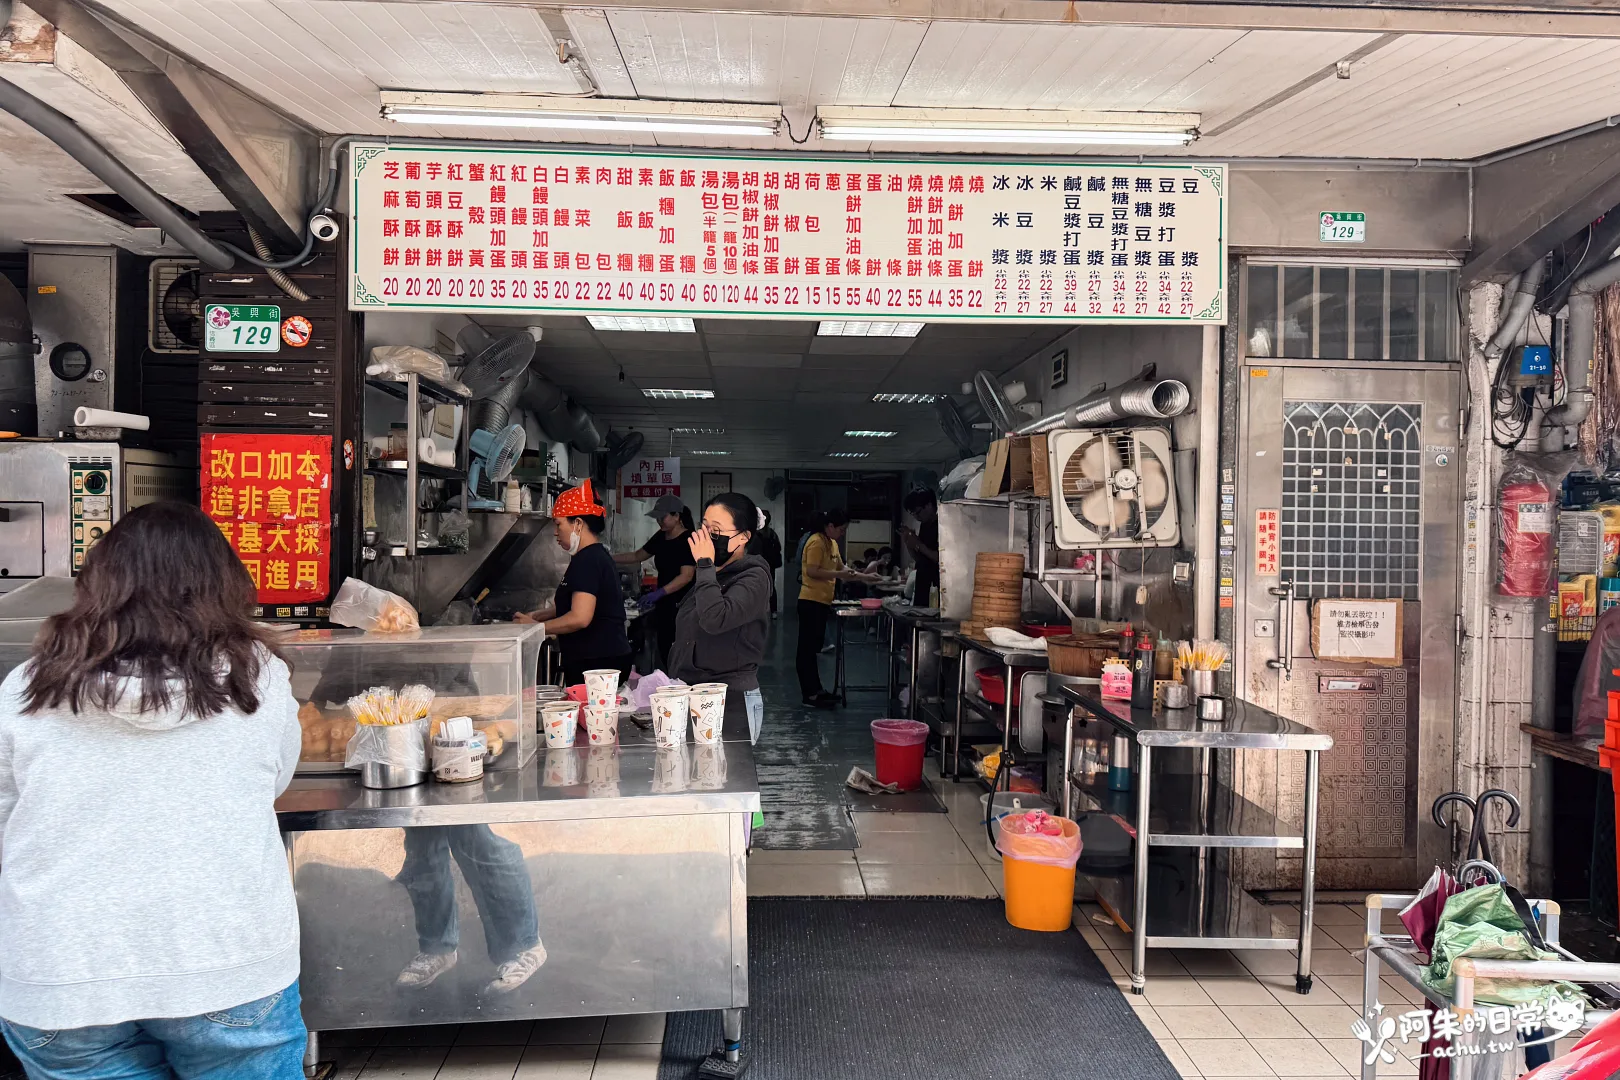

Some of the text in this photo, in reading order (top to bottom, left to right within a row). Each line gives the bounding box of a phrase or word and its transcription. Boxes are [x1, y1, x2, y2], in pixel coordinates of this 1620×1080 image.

[383, 161, 400, 266] 芝麻酥餅
[404, 161, 421, 266] 葡萄酥餅
[426, 162, 443, 267] 芋頭酥餅
[447, 163, 464, 267] 紅豆酥餅
[490, 164, 506, 269] 紅饅頭加蛋
[511, 165, 527, 269] 紅饅頭
[532, 165, 548, 269] 白饅頭加蛋
[554, 166, 570, 270] 白饅頭
[575, 166, 590, 270] 素菜包
[596, 167, 612, 270] 肉包
[742, 172, 759, 275] 胡椒餅加油條
[764, 172, 779, 274] 胡椒餅加蛋
[784, 172, 801, 275] 胡椒餅
[804, 173, 821, 275] 荷包蛋
[846, 173, 862, 275] 蛋餅加油條
[866, 173, 882, 276] 蛋餅
[886, 174, 902, 276] 油條
[907, 174, 923, 276] 燒餅加蛋餅
[927, 175, 944, 276] 燒餅加油條
[948, 175, 965, 277] 燒餅加蛋
[968, 175, 984, 278] 燒餅
[992, 175, 1009, 264] 冰米漿
[1016, 175, 1033, 264] 冰豆漿
[1040, 176, 1057, 264] 米漿
[1064, 176, 1082, 265] 鹹豆漿打蛋
[1087, 176, 1105, 265] 鹹豆漿
[1111, 177, 1129, 266] 無糖豆漿打蛋
[1135, 177, 1152, 266] 無糖豆漿
[1158, 178, 1175, 266] 豆漿打蛋
[1182, 178, 1199, 266] 豆漿
[1332, 226, 1354, 238] 129
[231, 307, 278, 319] 吳興街
[232, 325, 272, 345] 129
[383, 278, 982, 308] 20 20 20 20 20 35 20 35 20 22 22 40 40 50 40 60 120 44 35 22 15 15 55 40 22 55 44 35 22
[995, 278, 1193, 292] 22 22 22 39 27 34 22 34 22
[995, 302, 1193, 314] 27 27 27 44 32 42 27 42 27
[265, 450, 292, 591] 加拿大進
[295, 450, 321, 591] 本店採用
